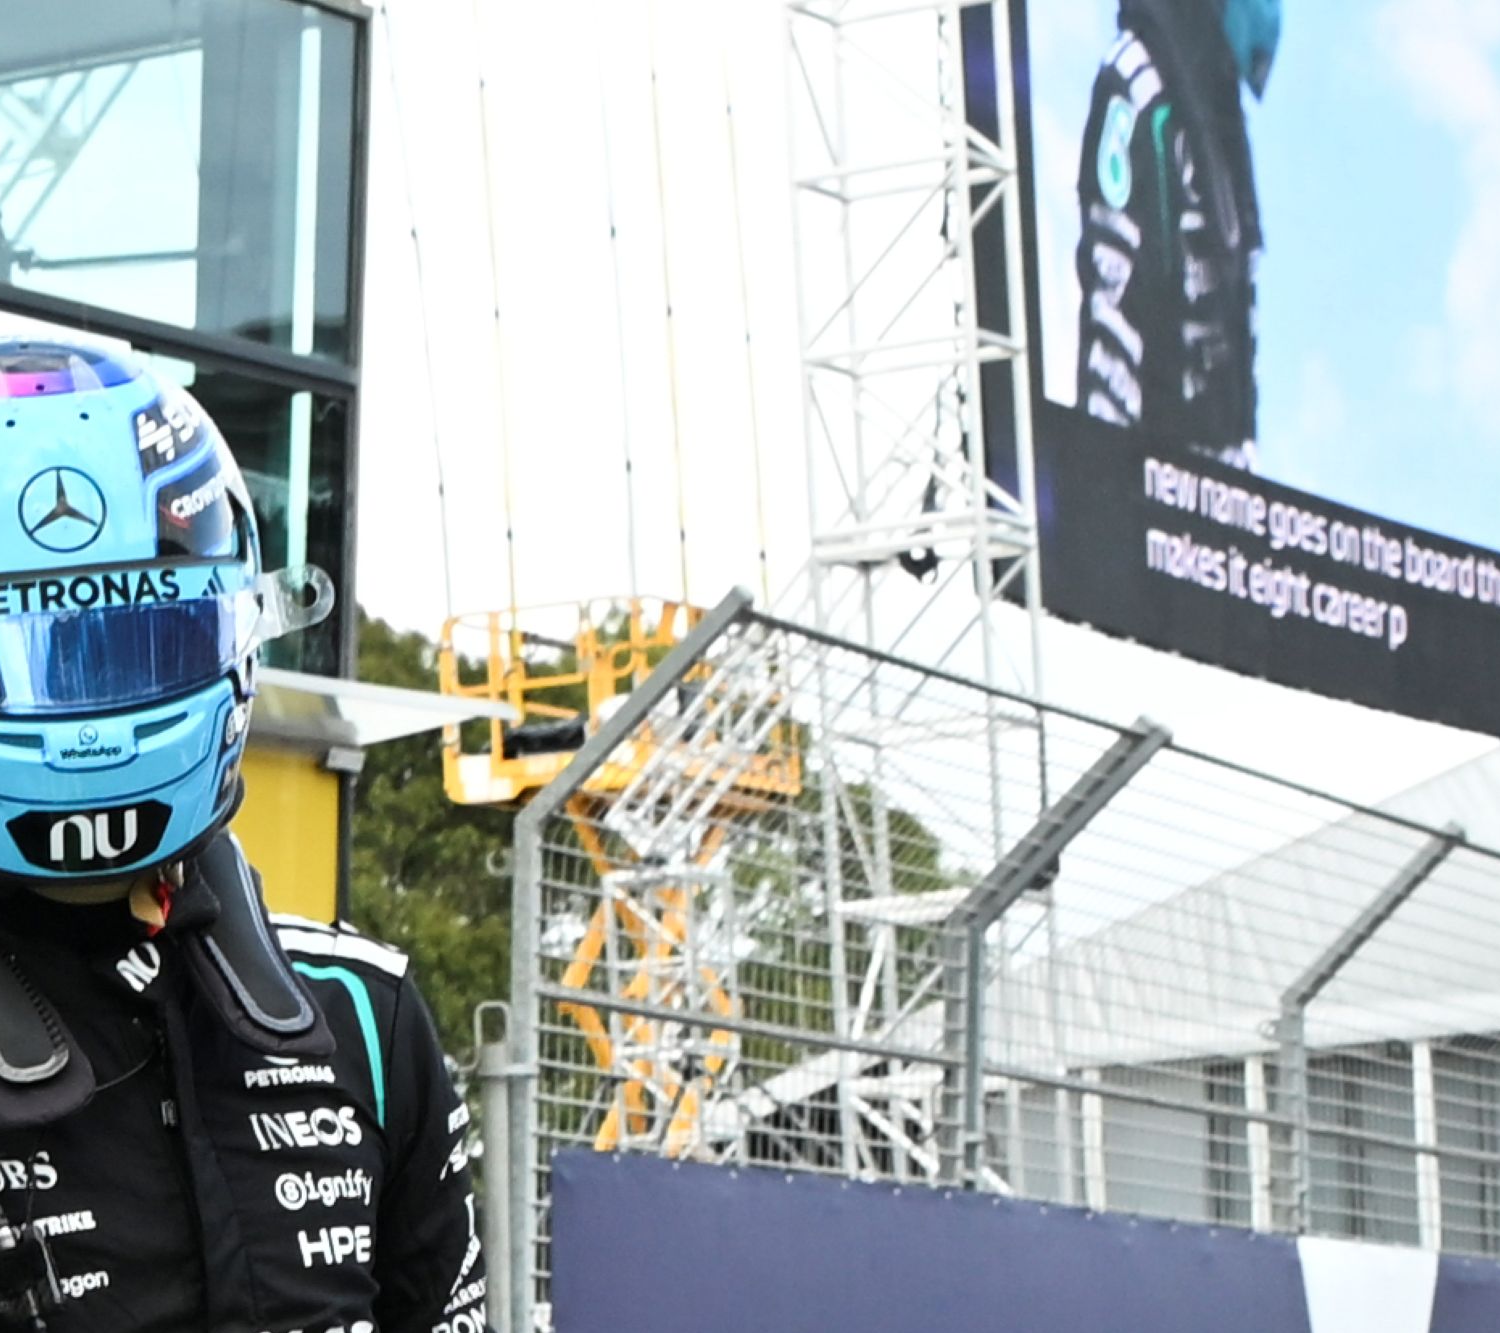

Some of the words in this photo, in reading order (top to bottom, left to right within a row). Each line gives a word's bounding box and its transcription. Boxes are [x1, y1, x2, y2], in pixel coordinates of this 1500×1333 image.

[1144, 457, 1199, 512] new
[1199, 477, 1267, 537] name
[1269, 500, 1328, 556] goes
[1329, 520, 1361, 566] on
[1362, 524, 1402, 579] the
[1404, 536, 1476, 600] board
[1146, 527, 1228, 592] makes
[1227, 546, 1248, 600] it
[1248, 557, 1311, 619] eight
[1312, 583, 1388, 639] career
[1388, 602, 1408, 652] p
[60, 745, 122, 761] WhatsApp
[243, 1062, 337, 1089] PETRONAS
[248, 1105, 363, 1152] INEOS
[297, 1225, 373, 1268] HPE
